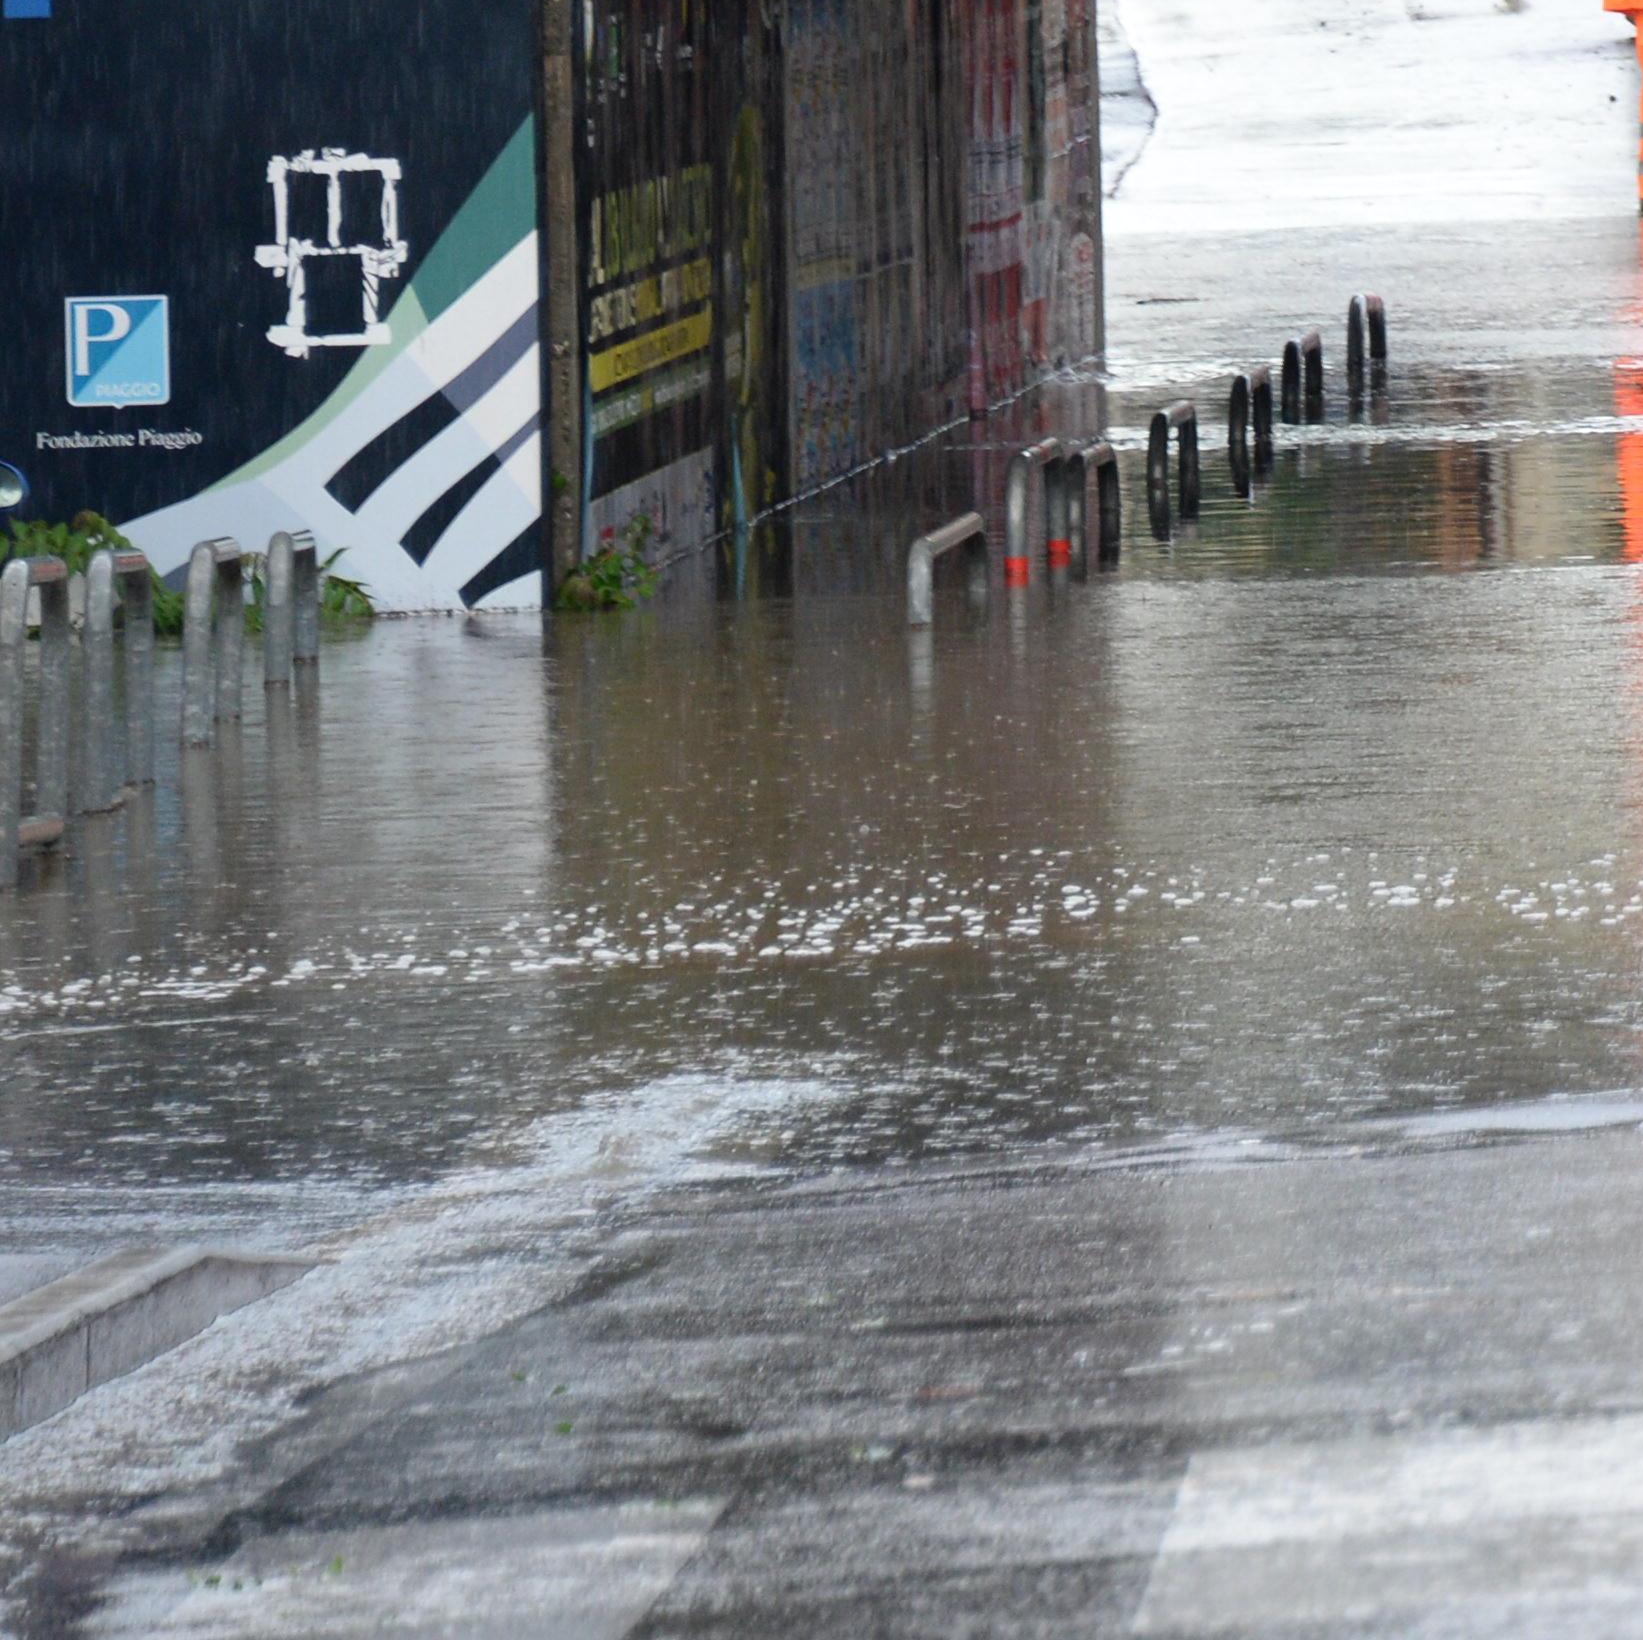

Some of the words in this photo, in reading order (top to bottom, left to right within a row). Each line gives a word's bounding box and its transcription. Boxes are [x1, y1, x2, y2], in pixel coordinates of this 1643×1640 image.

[96, 383, 161, 397] PIAGGIO
[36, 430, 135, 449] Fondazione
[138, 427, 203, 450] Piaggio
